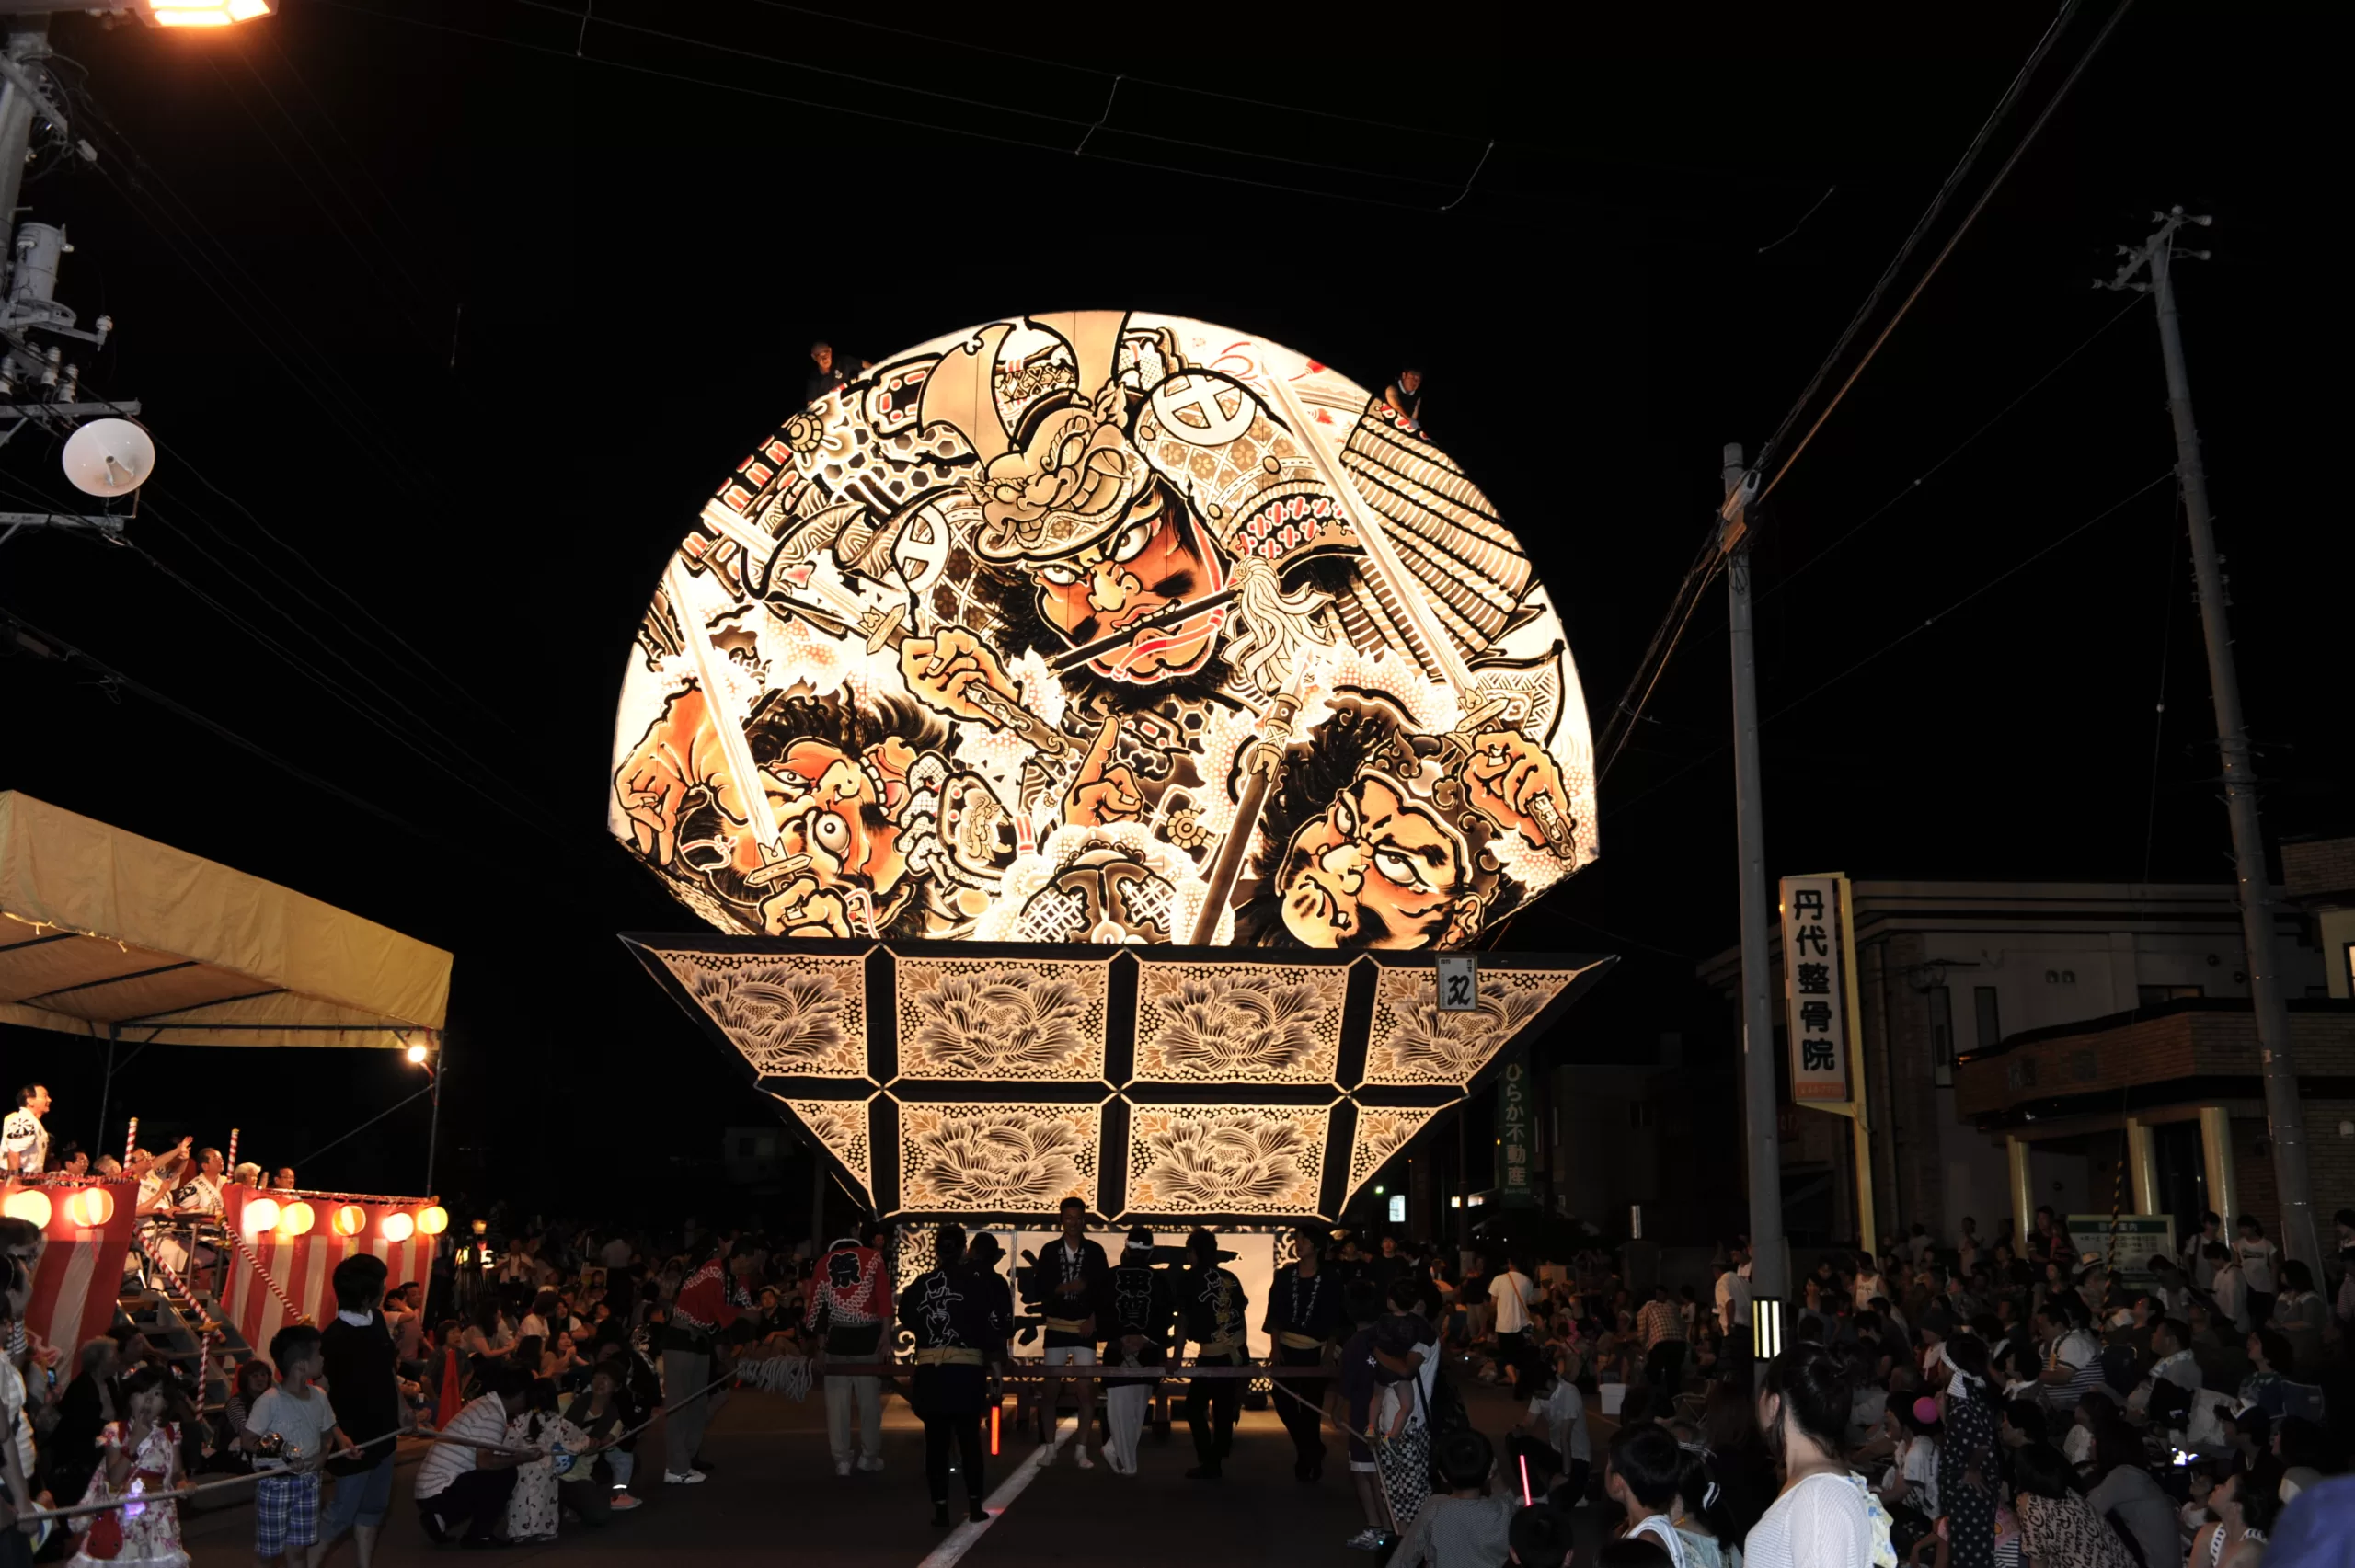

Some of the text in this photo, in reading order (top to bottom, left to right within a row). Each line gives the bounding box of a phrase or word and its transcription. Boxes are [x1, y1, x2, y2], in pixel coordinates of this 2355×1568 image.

[1447, 975, 1471, 1006] 32
[1794, 890, 1834, 1071] 丹代整骨院
[1505, 1062, 1528, 1186] ひらか不動産
